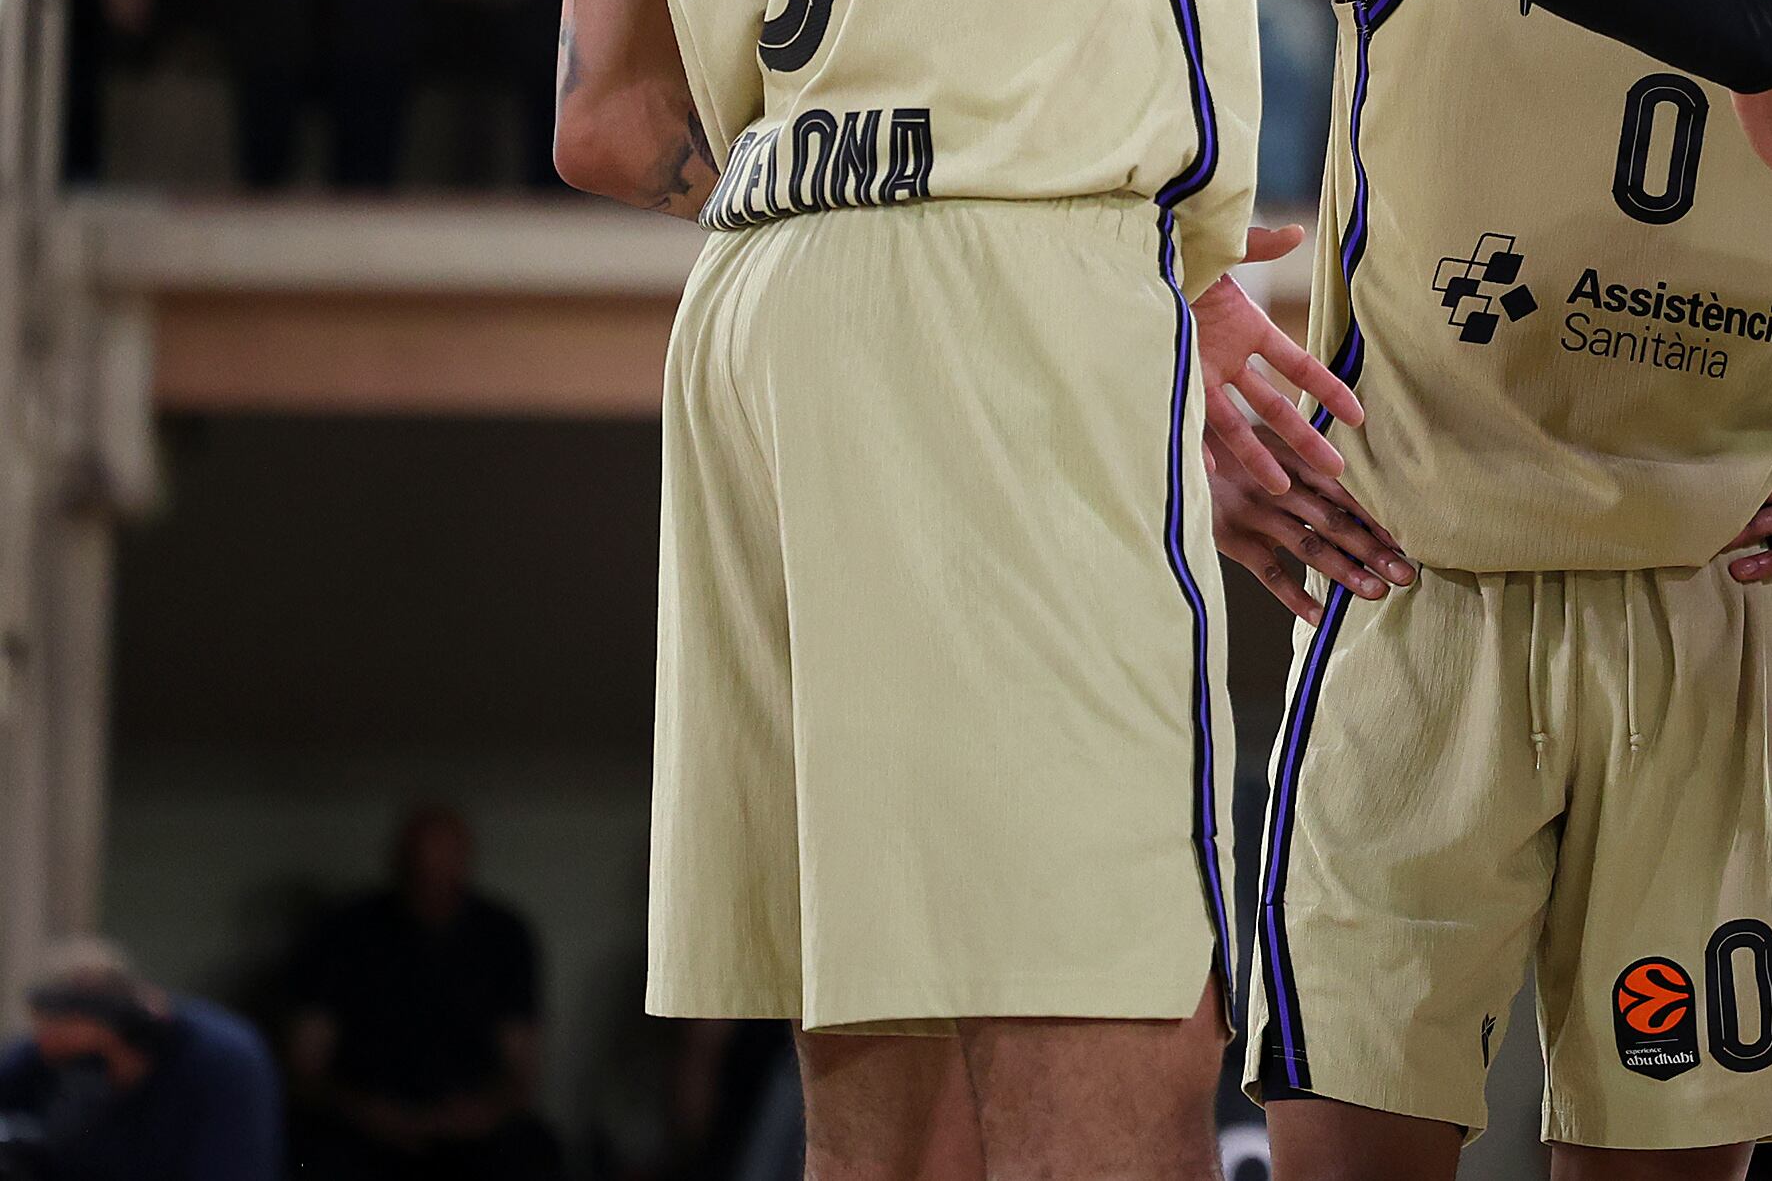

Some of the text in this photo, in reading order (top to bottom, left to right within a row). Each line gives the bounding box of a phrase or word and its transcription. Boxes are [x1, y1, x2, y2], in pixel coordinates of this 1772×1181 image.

[1612, 73, 1709, 225] 0
[1560, 312, 1729, 380] Sanitària
[1625, 1047, 1662, 1056] experience
[1626, 1050, 1695, 1066] abu dhabi
